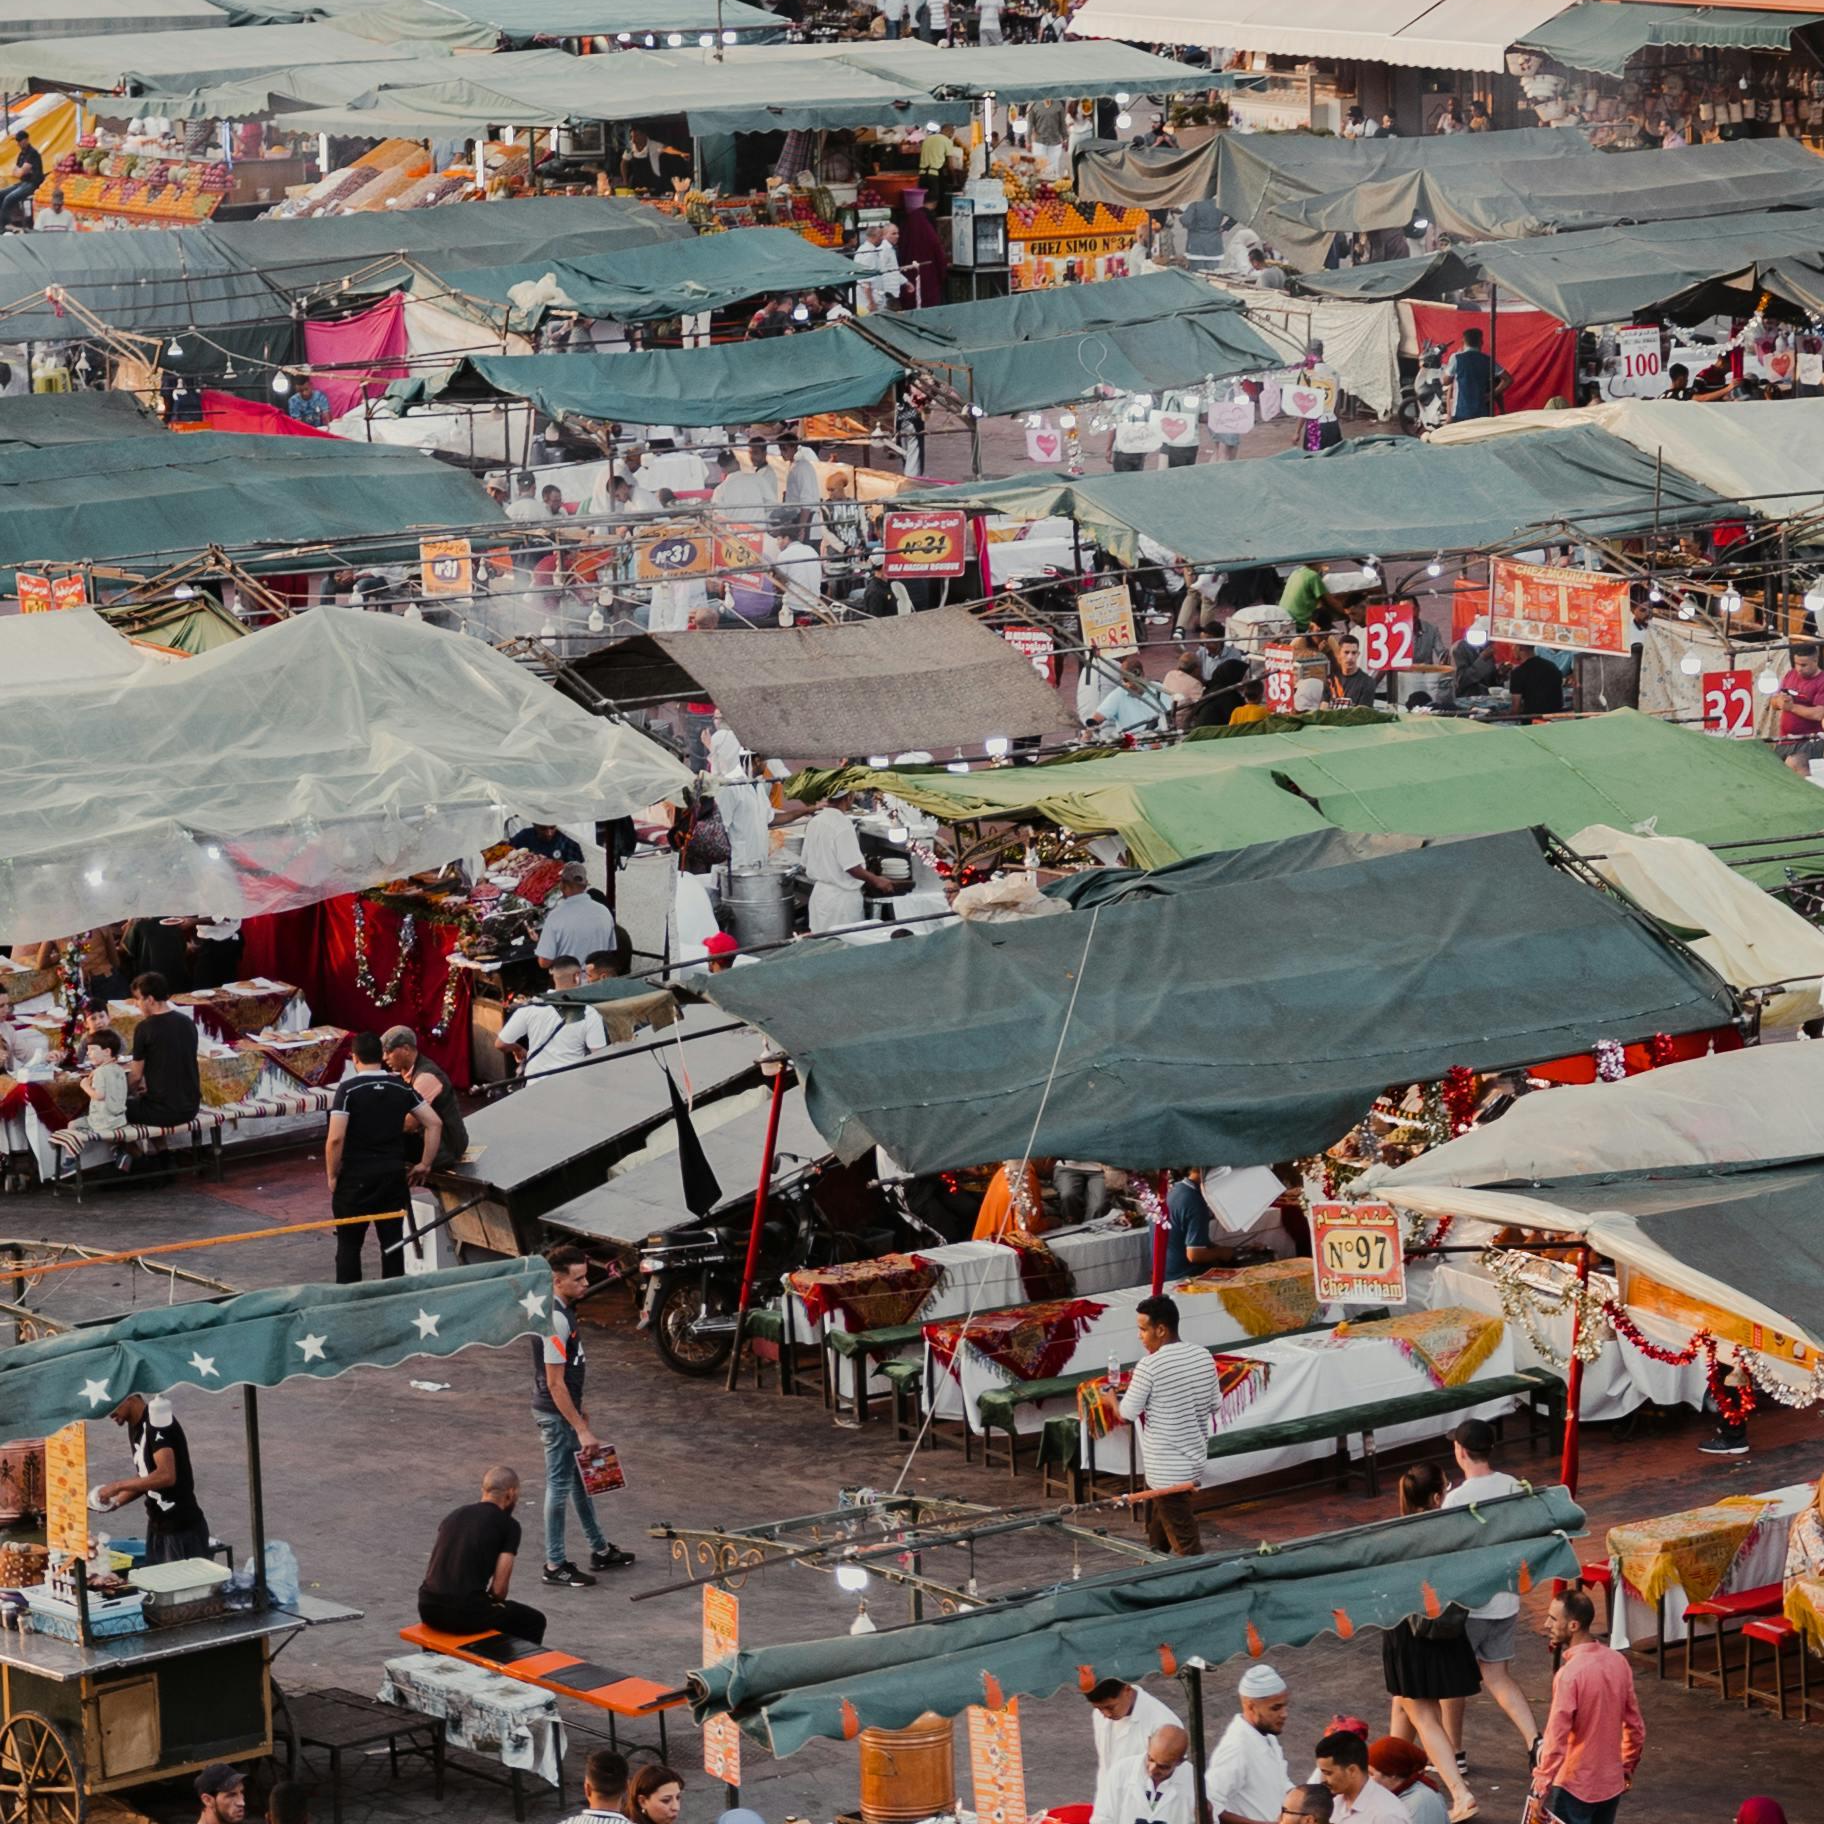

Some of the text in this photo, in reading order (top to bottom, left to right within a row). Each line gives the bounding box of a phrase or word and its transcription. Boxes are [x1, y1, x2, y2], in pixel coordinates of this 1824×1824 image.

[1030, 241, 1062, 256] CHEZ
[1065, 238, 1098, 253] SIMO
[1625, 352, 1659, 378] 100
[655, 543, 692, 565] N°31
[1514, 564, 1545, 576] CHEZ
[1368, 621, 1413, 669] 32
[1268, 672, 1292, 702] 85
[1705, 688, 1752, 736] 32
[1316, 1207, 1396, 1232] عند هشام
[1328, 1235, 1387, 1270] N°97
[1321, 1277, 1402, 1298] Chez Hicham
